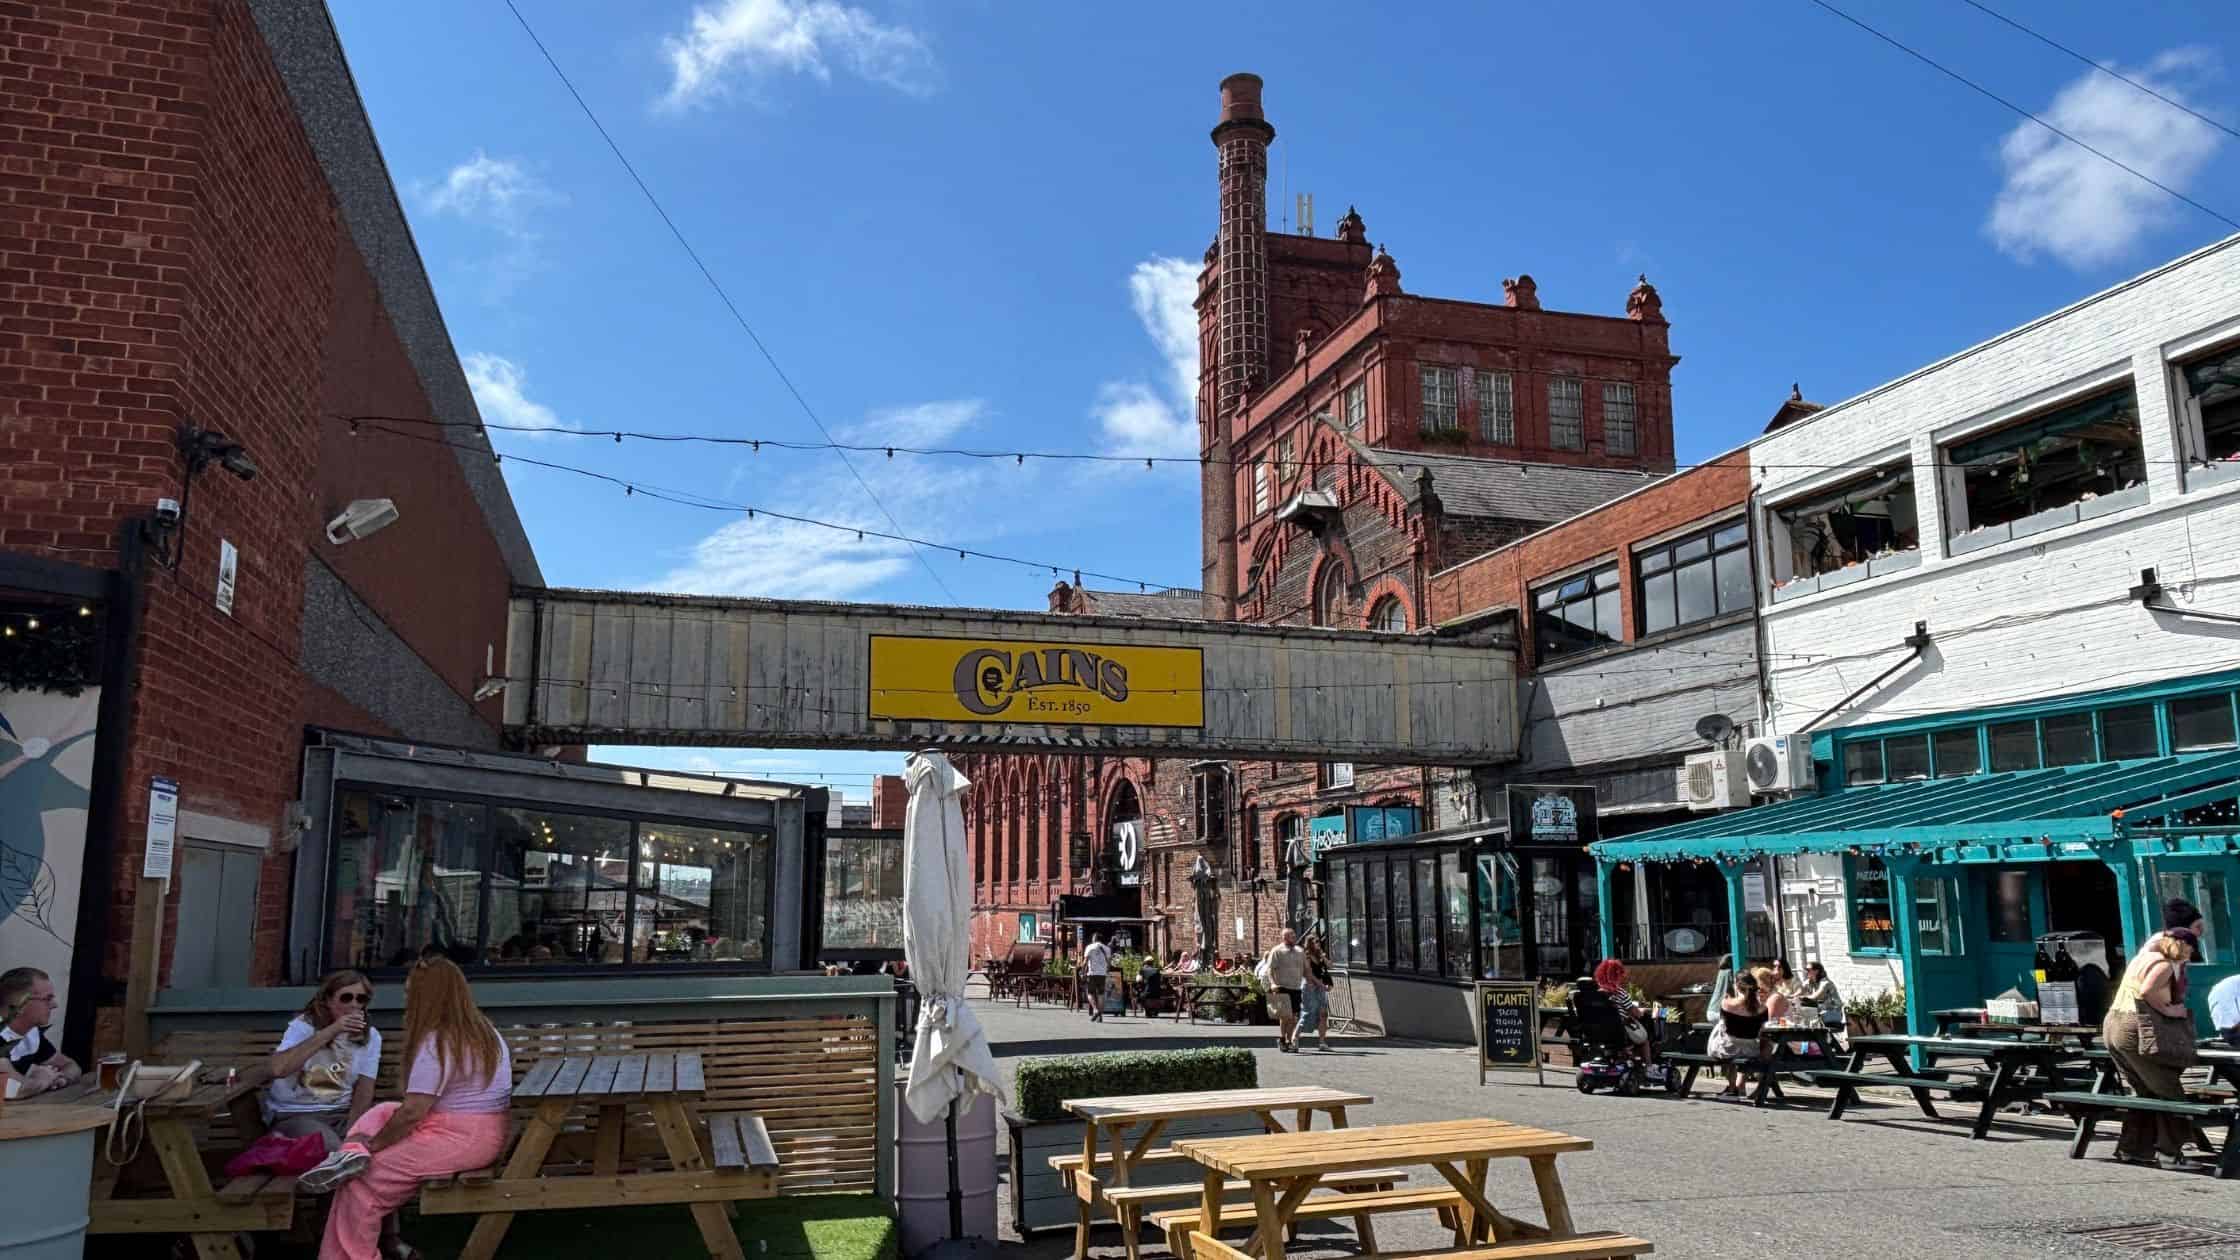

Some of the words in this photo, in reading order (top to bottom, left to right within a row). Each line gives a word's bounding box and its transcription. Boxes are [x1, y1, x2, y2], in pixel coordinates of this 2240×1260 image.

[953, 648, 1128, 716] CAINS
[1061, 698, 1091, 716] 1850
[1486, 993, 1529, 1006] PICANTE
